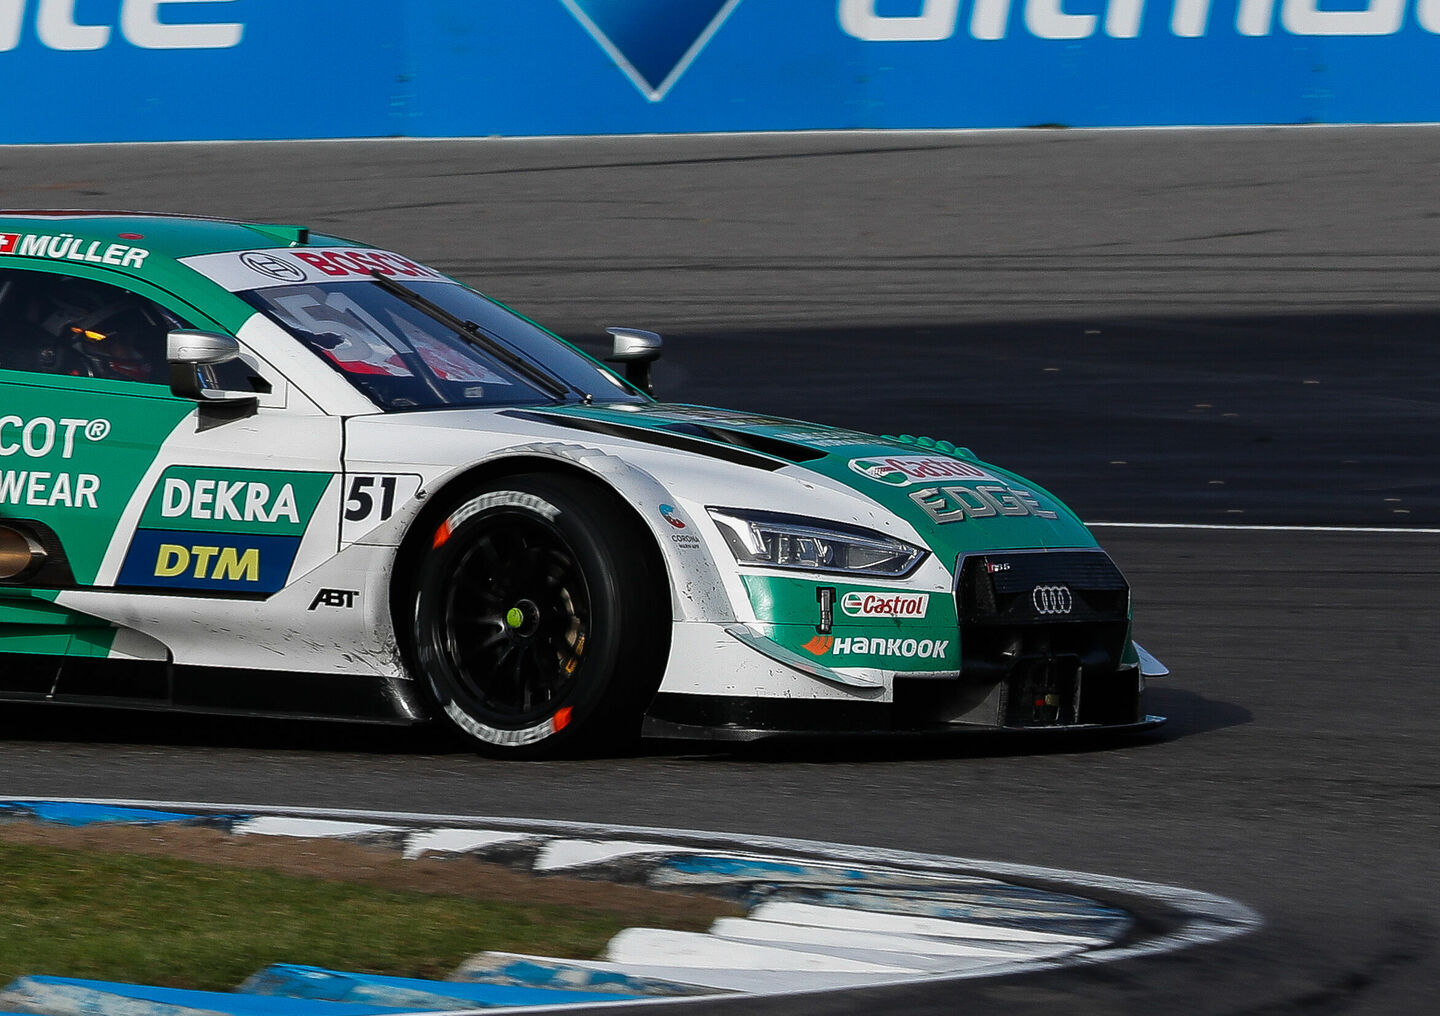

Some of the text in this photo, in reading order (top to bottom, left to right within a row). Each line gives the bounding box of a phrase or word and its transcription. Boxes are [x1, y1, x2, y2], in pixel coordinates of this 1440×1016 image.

[18, 232, 150, 269] MÜLLER
[290, 251, 441, 278] BOSCH
[161, 478, 300, 524] DEKRA
[345, 476, 397, 522] 51
[909, 485, 1058, 524] EDGE
[154, 544, 259, 581] DTM
[307, 588, 360, 611] ABT
[863, 595, 923, 615] Castrol
